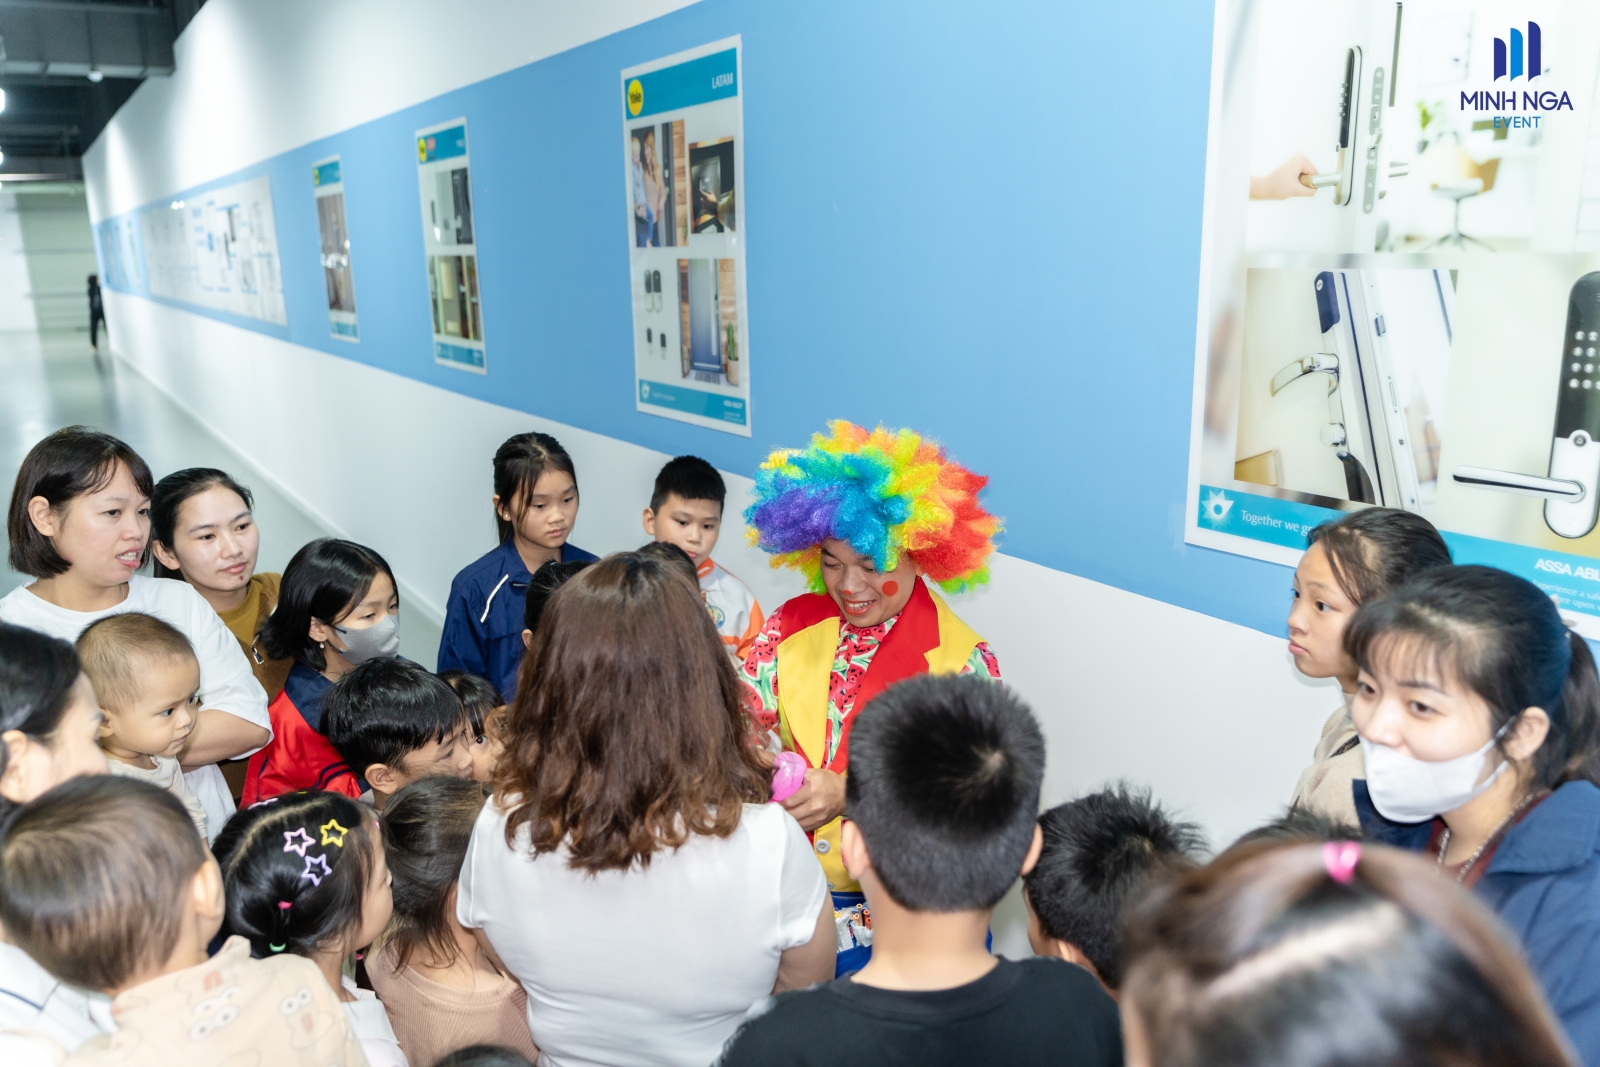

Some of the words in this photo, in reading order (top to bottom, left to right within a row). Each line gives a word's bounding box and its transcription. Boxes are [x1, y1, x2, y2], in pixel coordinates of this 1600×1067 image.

[711, 72, 733, 89] LATAM
[1241, 509, 1283, 528] Together
[1284, 521, 1300, 533] we
[1534, 558, 1572, 576] ASSA
